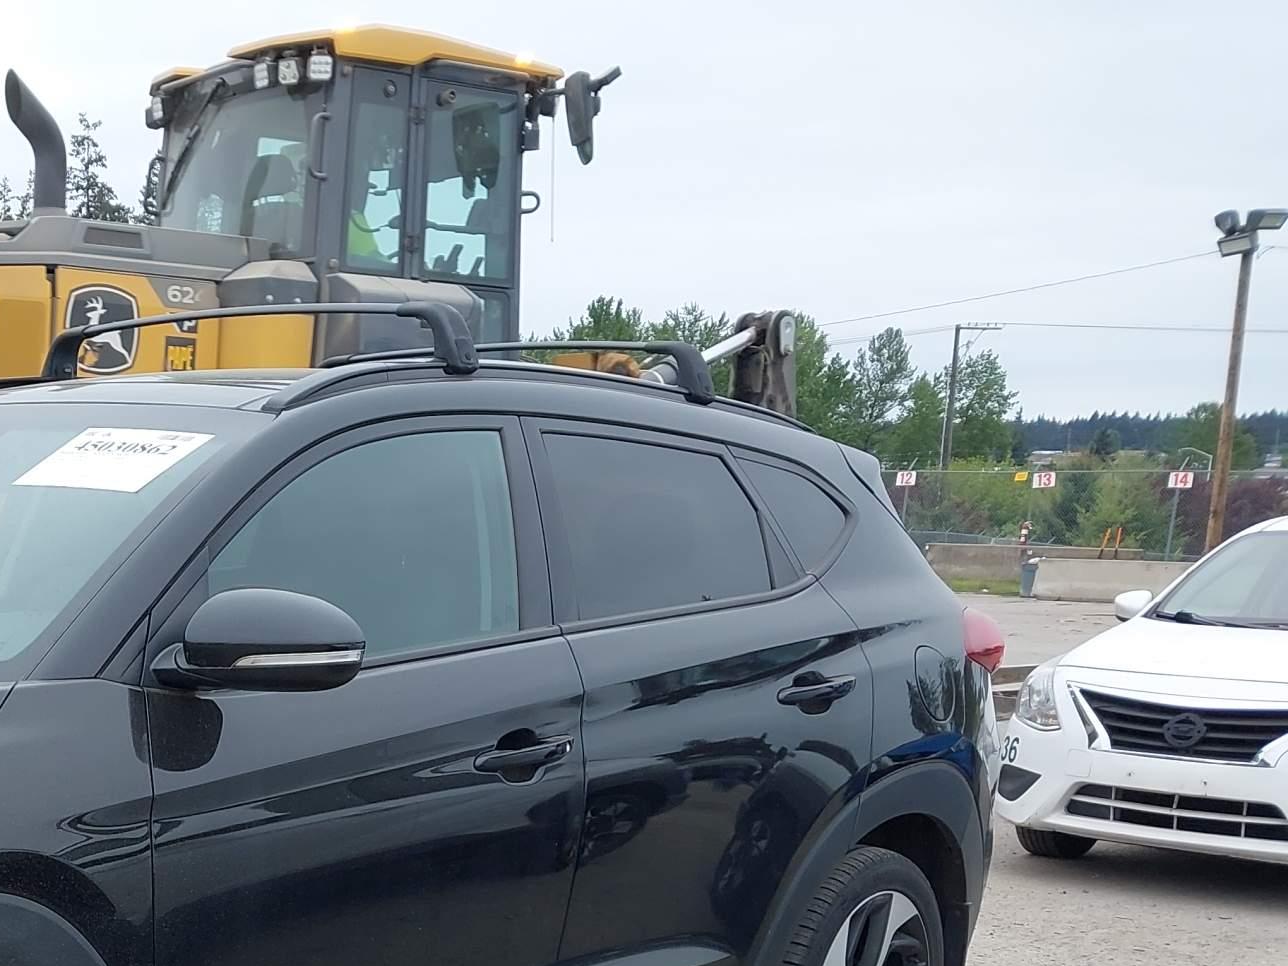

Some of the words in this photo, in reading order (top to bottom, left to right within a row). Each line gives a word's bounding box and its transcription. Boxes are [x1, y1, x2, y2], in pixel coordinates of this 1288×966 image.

[75, 440, 177, 455] 45030862
[899, 471, 913, 485] 12
[1037, 472, 1052, 486] 13
[1173, 472, 1189, 487] 14
